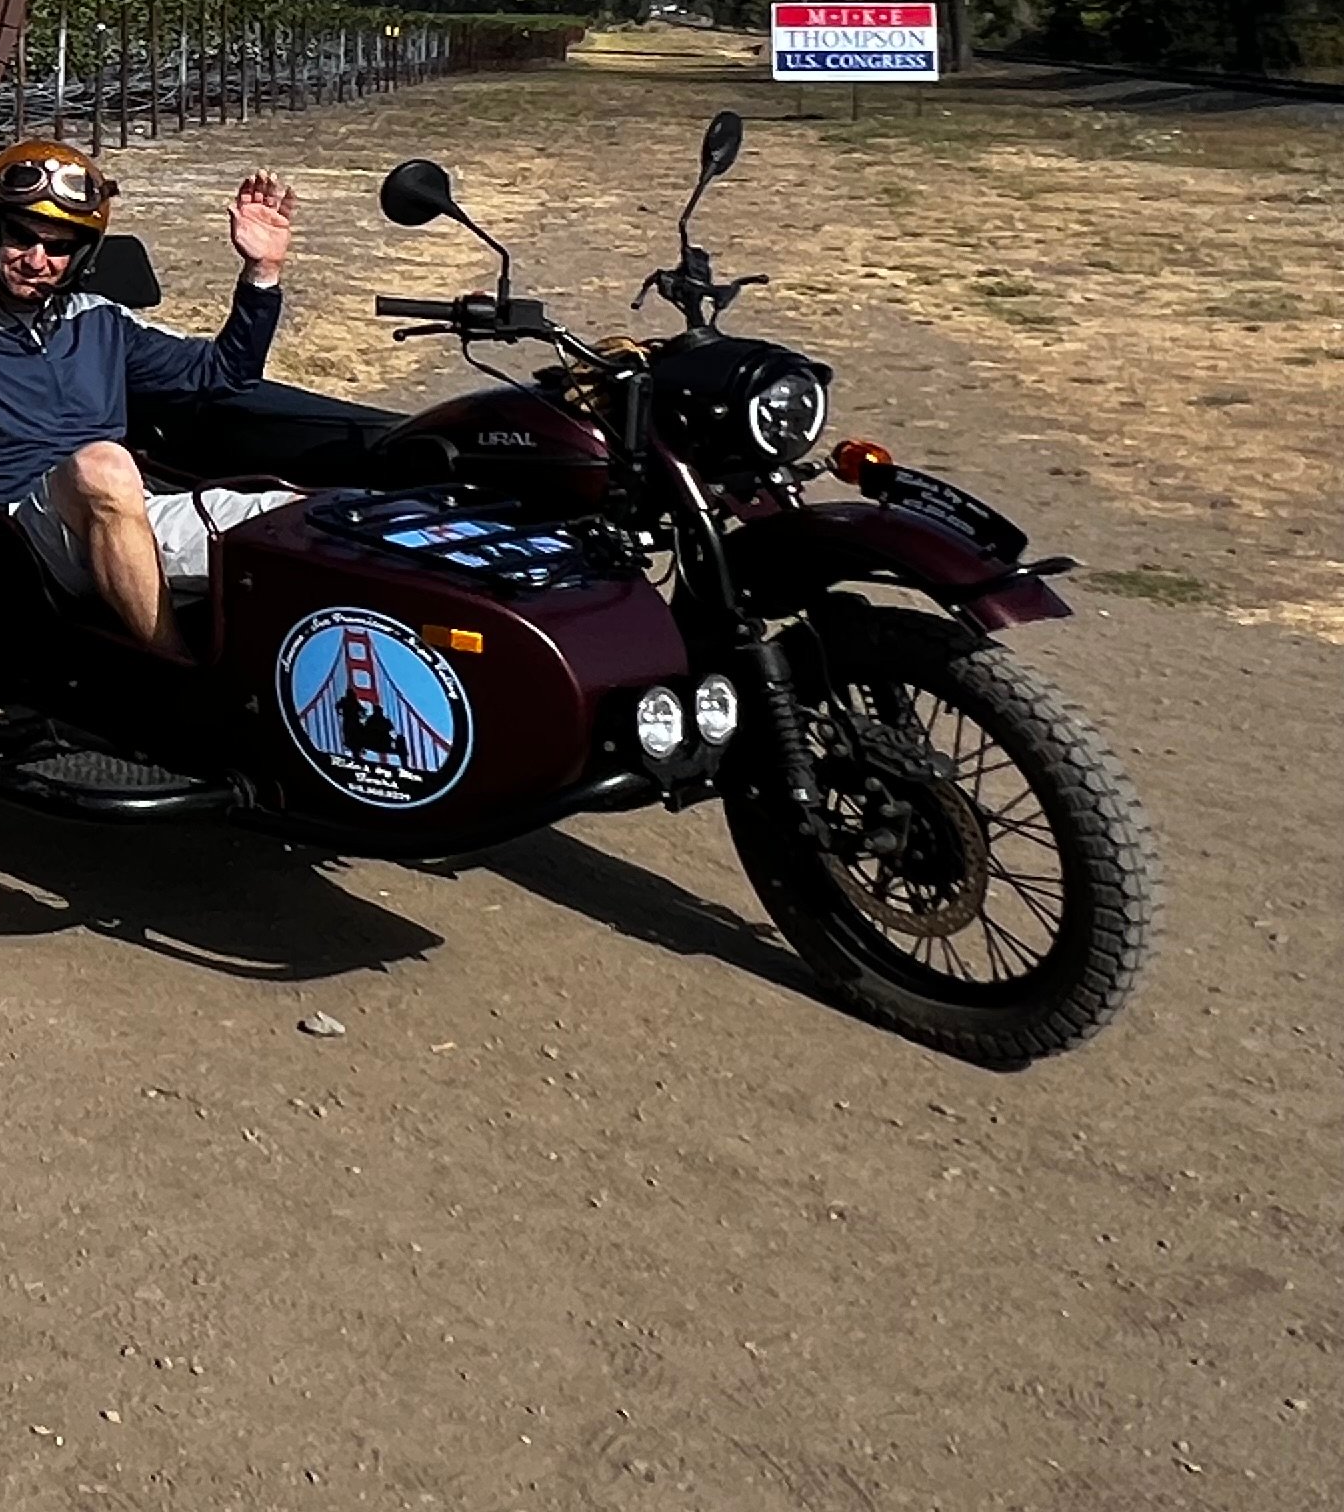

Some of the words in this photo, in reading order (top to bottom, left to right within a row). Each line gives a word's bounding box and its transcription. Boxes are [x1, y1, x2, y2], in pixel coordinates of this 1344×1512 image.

[784, 30, 926, 48] THOMPSON
[824, 54, 927, 69] CONGRESS
[478, 431, 538, 447] URAL
